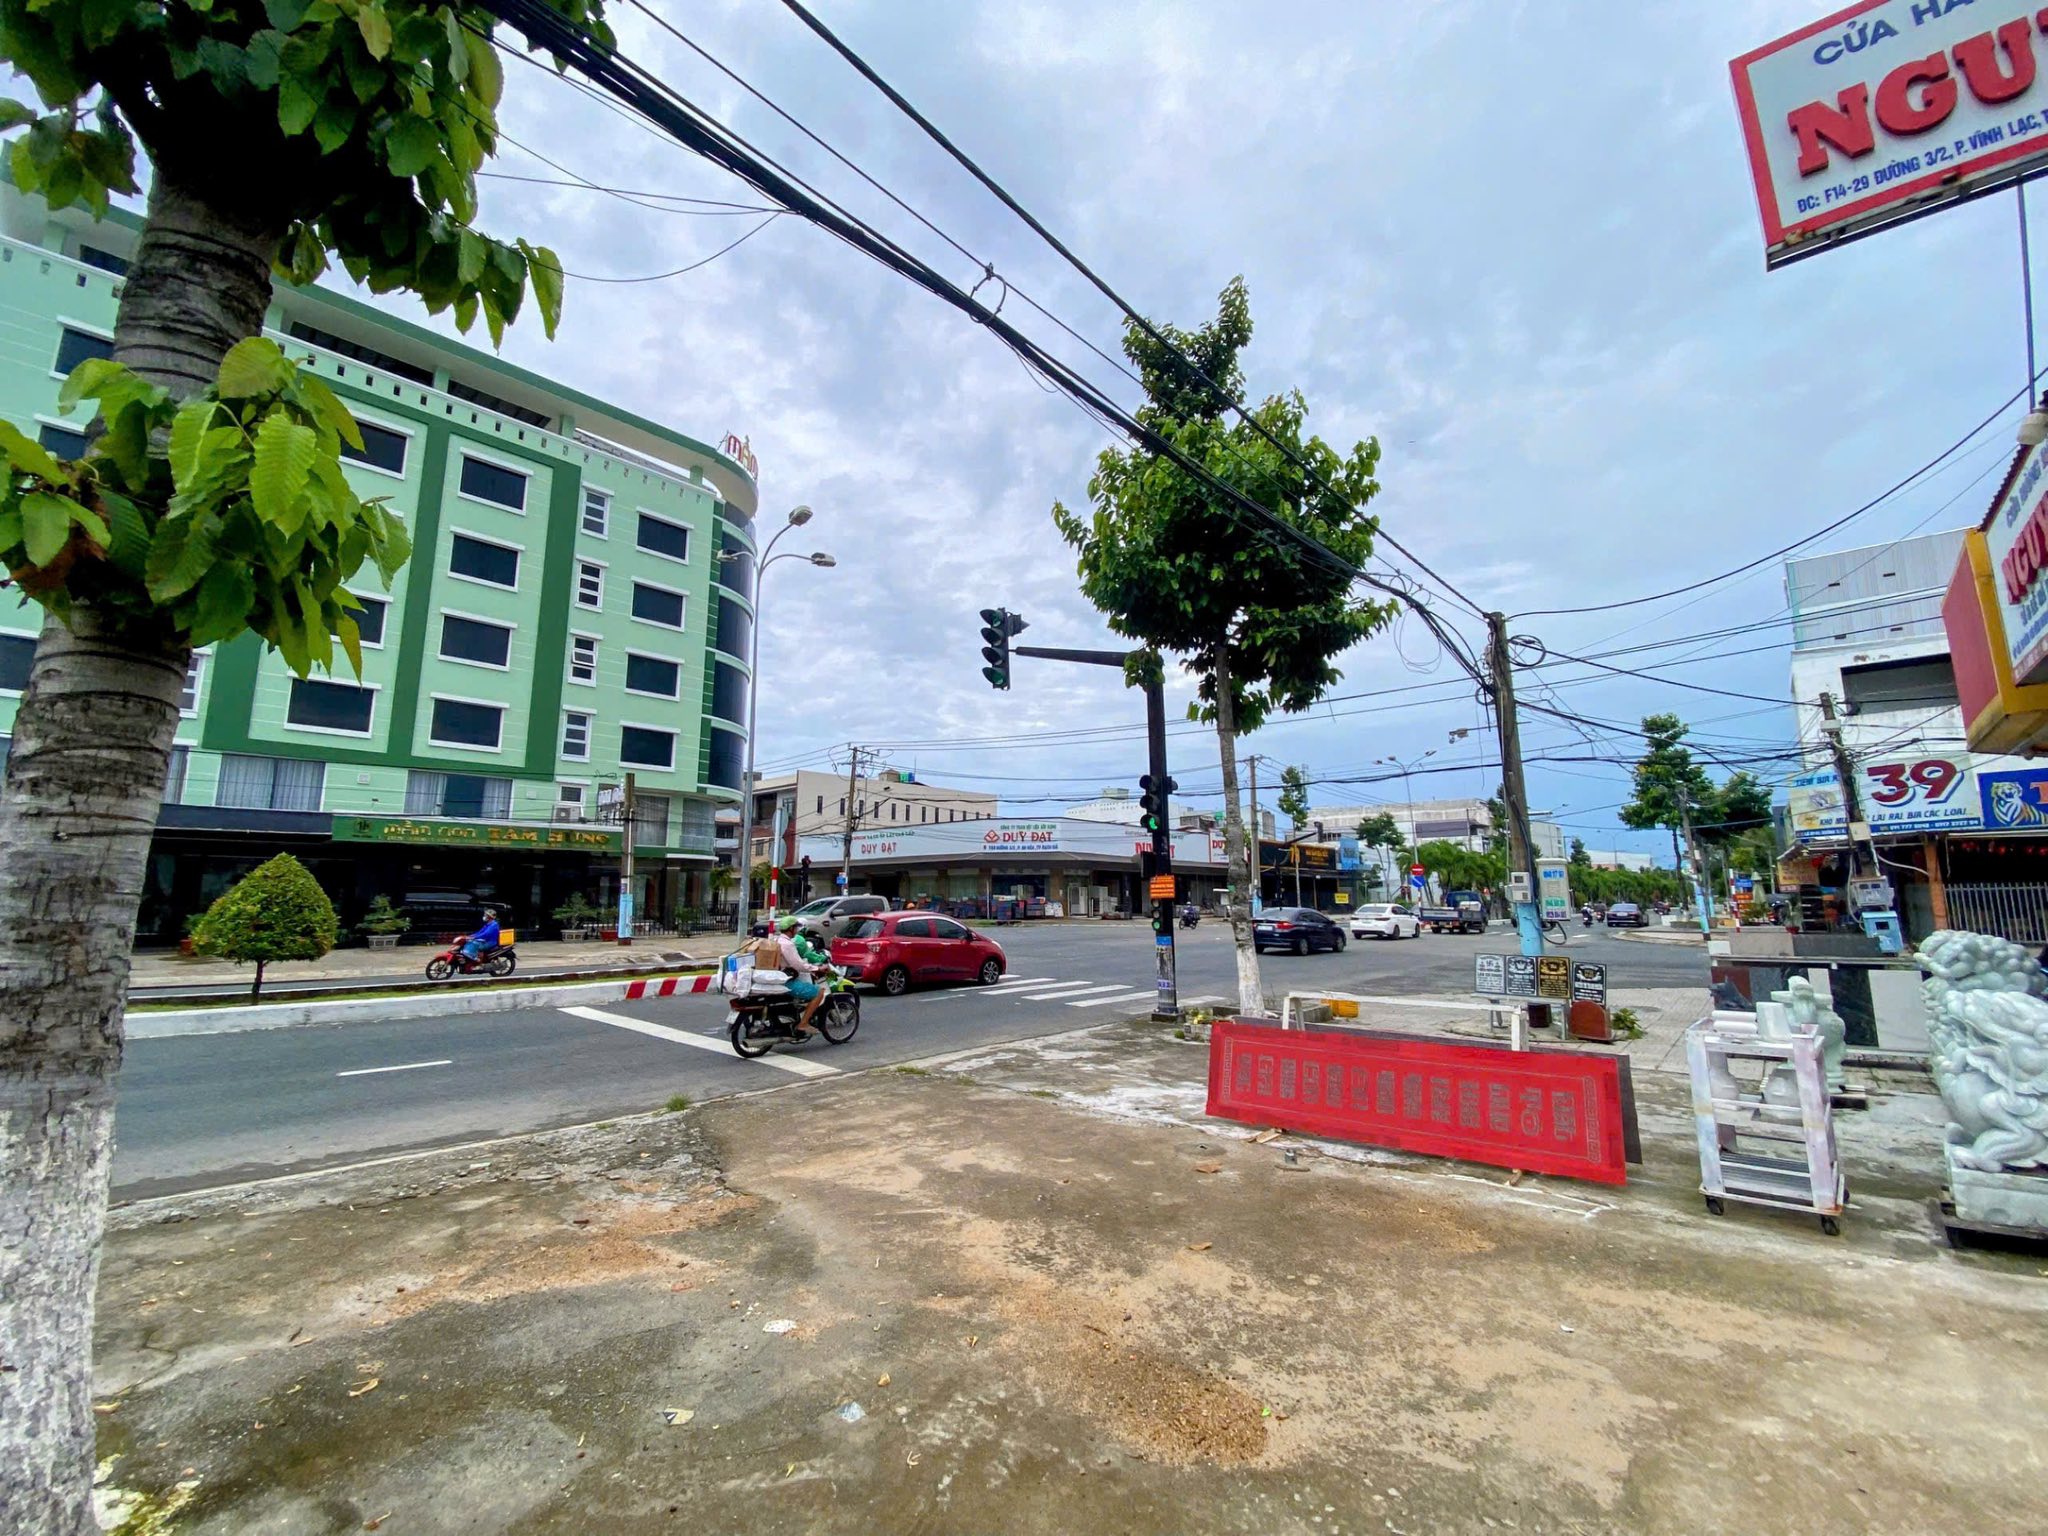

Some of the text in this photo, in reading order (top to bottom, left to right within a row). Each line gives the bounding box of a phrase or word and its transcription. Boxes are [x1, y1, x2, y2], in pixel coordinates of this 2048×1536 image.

[1813, 19, 1898, 65] CỬA
[1787, 9, 2048, 177] NGU
[1797, 195, 1820, 214] ĐC:
[1824, 176, 1870, 203] F14-29
[1874, 157, 1921, 186] ĐƯỜNG
[2008, 114, 2042, 136] LẠC,
[1867, 760, 1963, 807] 39
[861, 843, 878, 854] DUY
